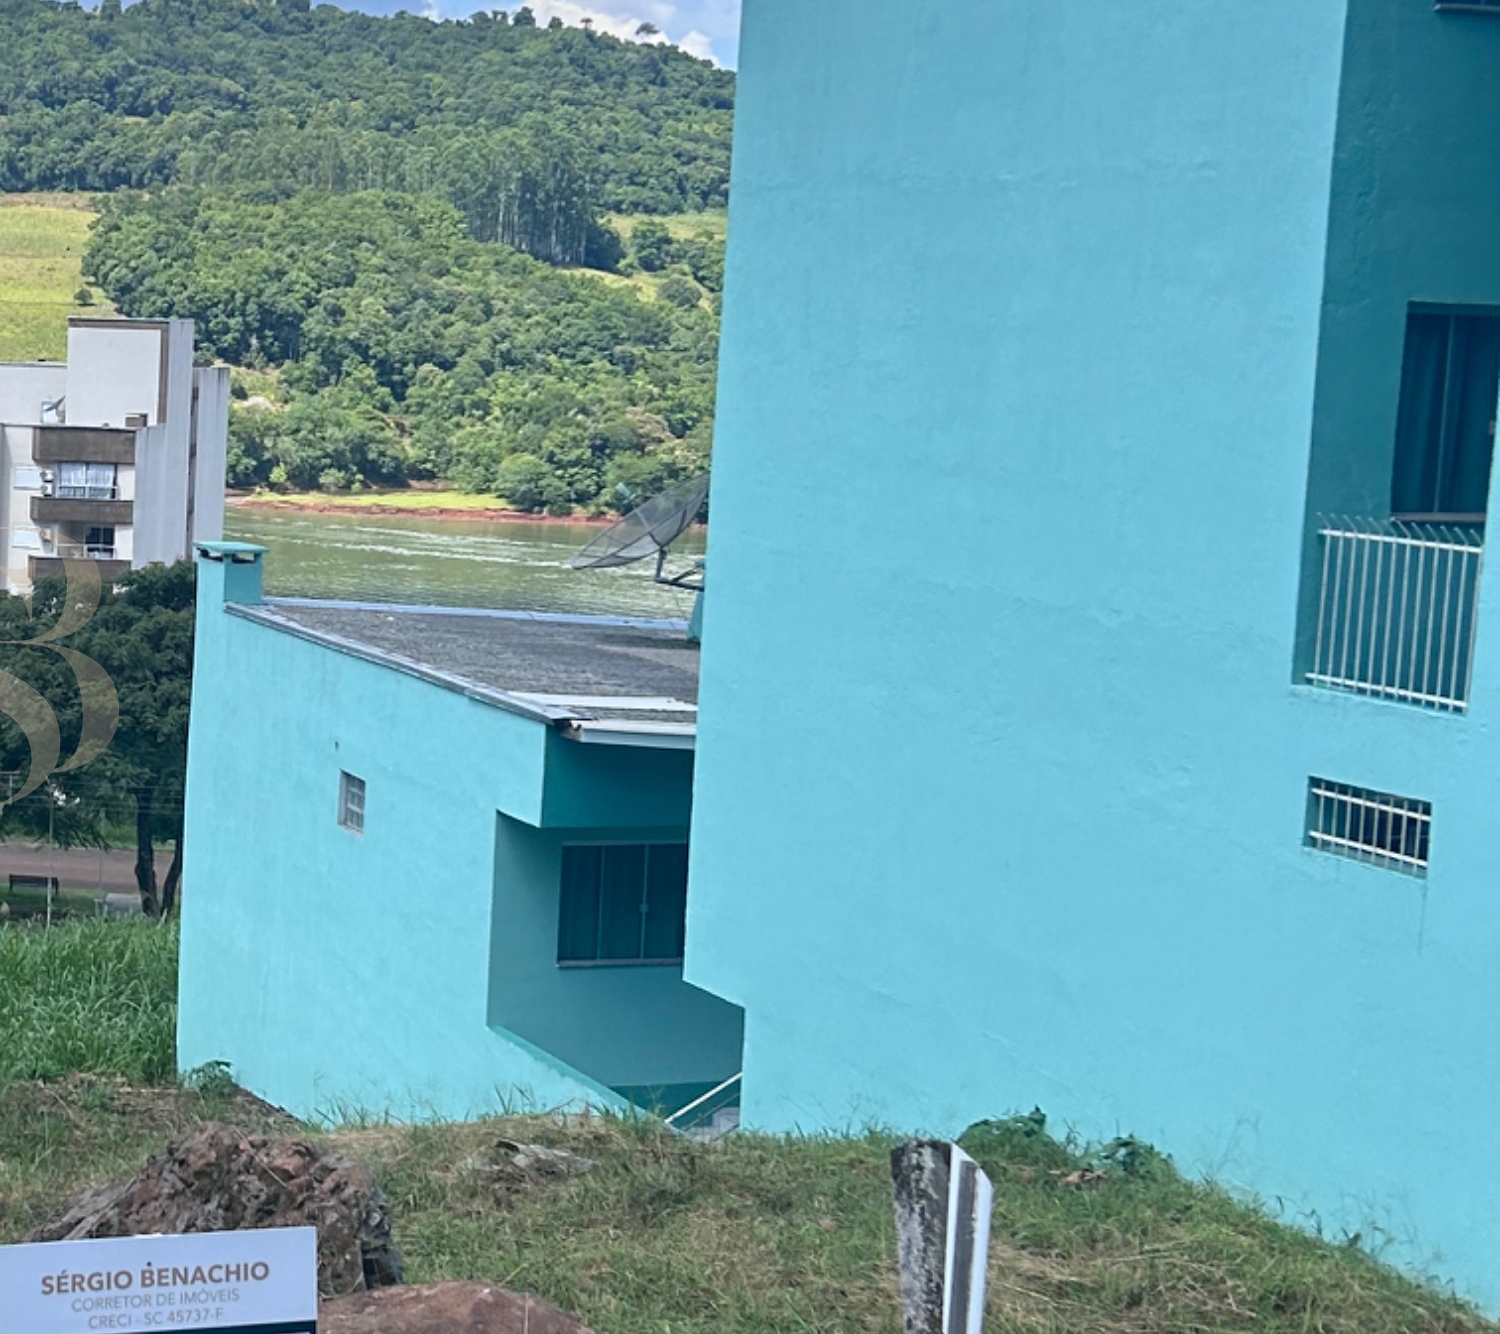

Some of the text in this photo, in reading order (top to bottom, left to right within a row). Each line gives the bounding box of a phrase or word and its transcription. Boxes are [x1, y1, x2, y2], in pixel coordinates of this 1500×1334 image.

[41, 1261, 270, 1296] SÉRGIO BENACHIO
[71, 1287, 240, 1313] CORRETOR DE IMÓVEIS
[88, 1313, 132, 1330] CRECI
[144, 1311, 164, 1326] SC
[167, 1307, 224, 1324] 45737-F
